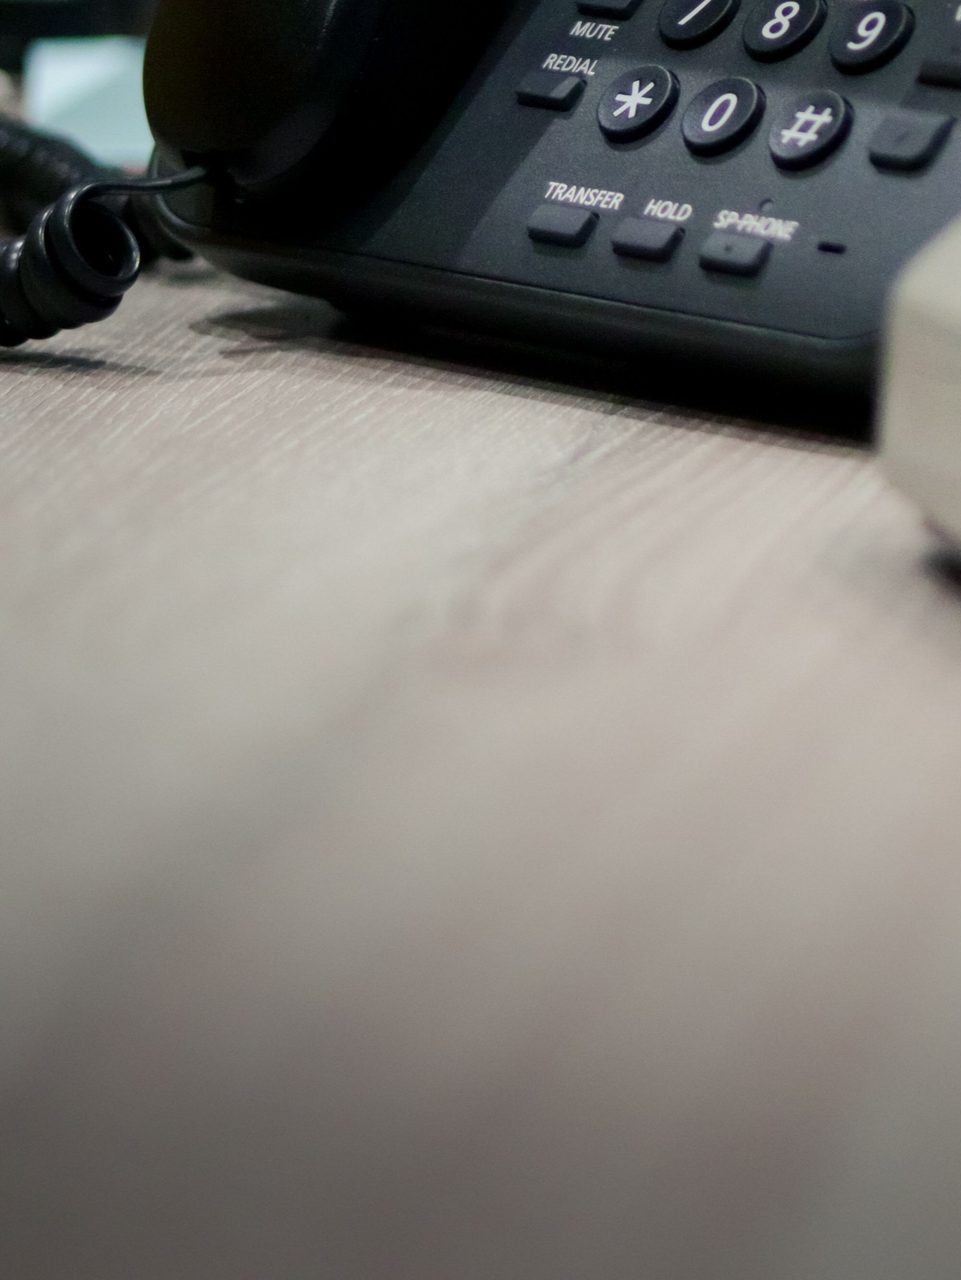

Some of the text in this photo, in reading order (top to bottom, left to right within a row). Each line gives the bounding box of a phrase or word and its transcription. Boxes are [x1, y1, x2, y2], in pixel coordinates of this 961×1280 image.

[569, 20, 619, 41] MUTE
[761, 1, 800, 39] 8
[846, 11, 887, 51] 9
[541, 53, 599, 76] REDIAL
[701, 92, 738, 132] 0
[780, 104, 833, 145] #
[544, 181, 625, 211] TRANSFER
[643, 198, 693, 221] HOLD
[713, 209, 800, 241] SP-PHONE
